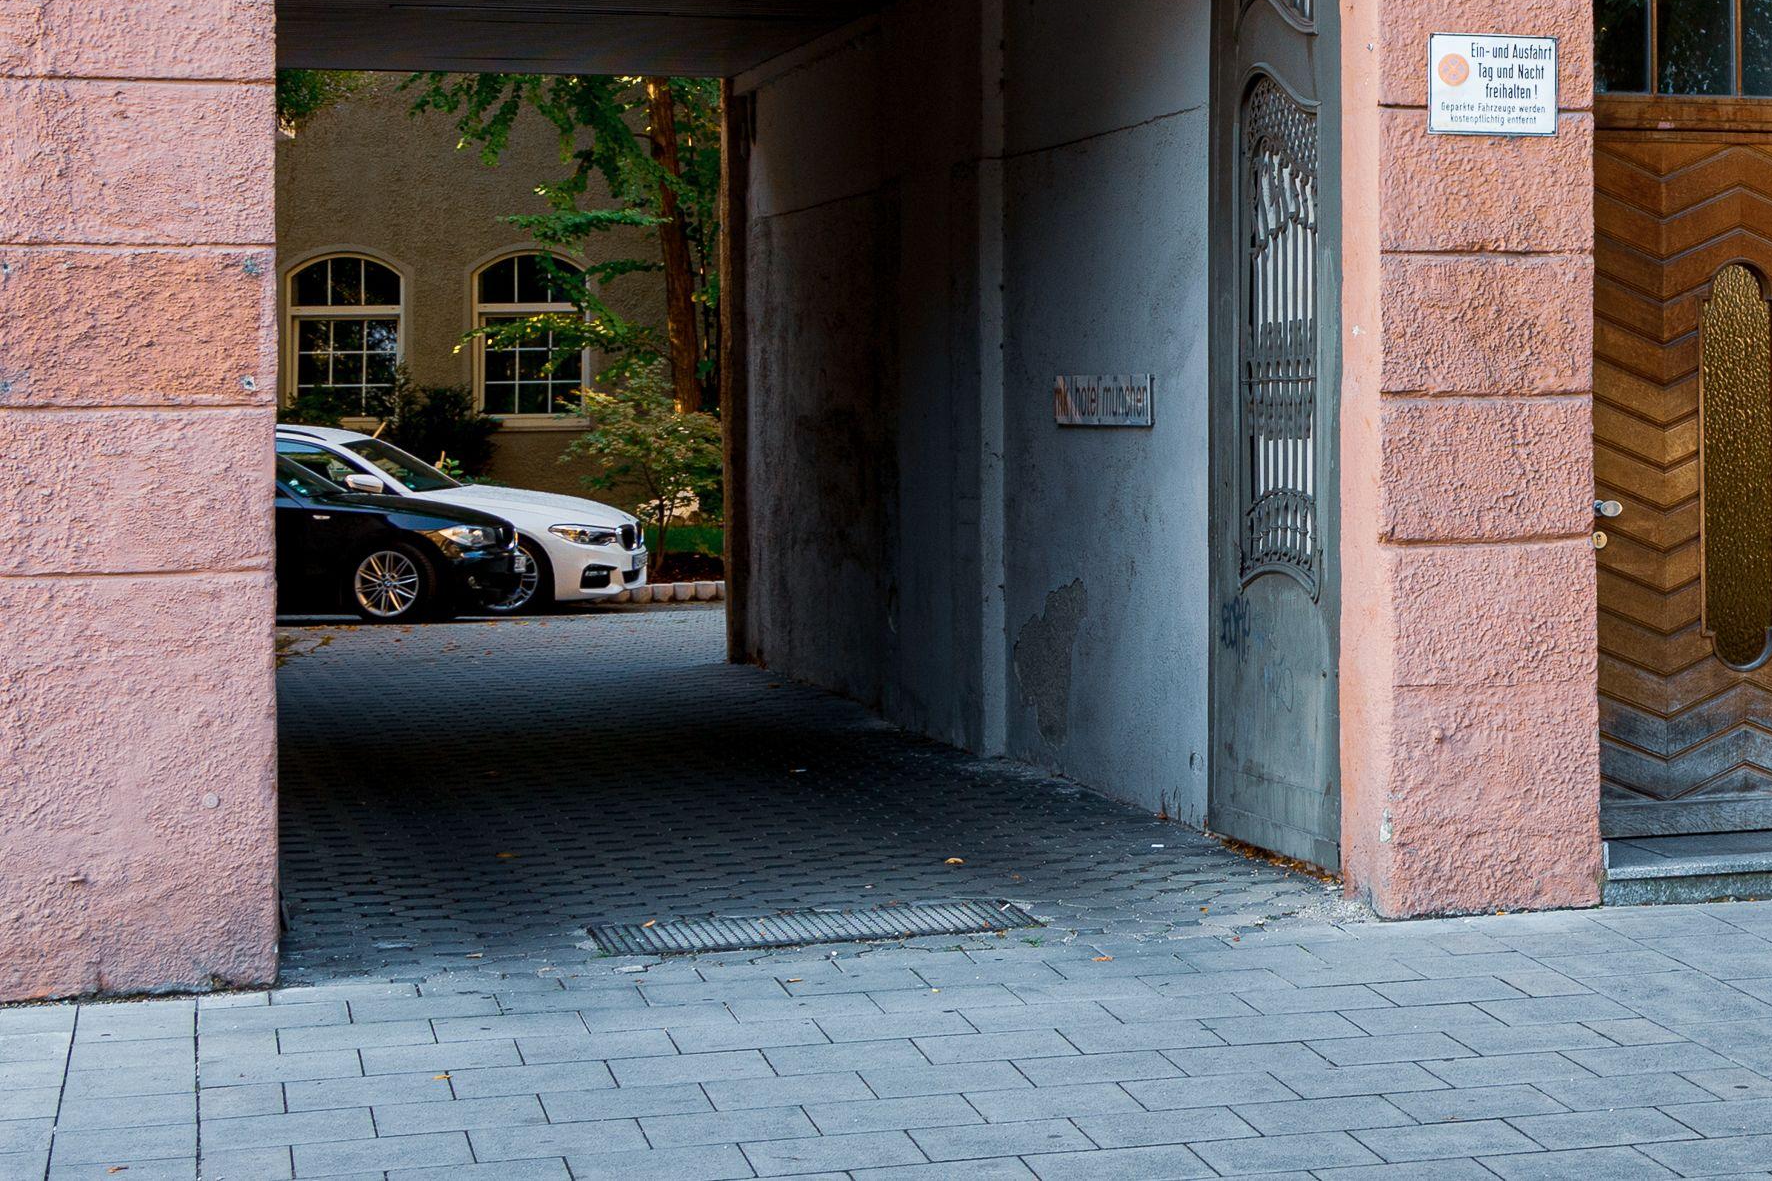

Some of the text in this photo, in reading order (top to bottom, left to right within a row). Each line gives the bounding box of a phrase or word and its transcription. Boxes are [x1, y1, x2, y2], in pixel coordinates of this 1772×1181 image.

[1492, 44, 1509, 59] und
[1512, 44, 1552, 60] Ausfahrt
[1478, 62, 1545, 81] Tag und Nacht
[1441, 101, 1546, 114] Geparkte Fahrzeuge werden
[1450, 113, 1537, 126] kostenpflichtig entfernt
[1075, 376, 1099, 417] hotel
[1102, 376, 1148, 418] münchen
